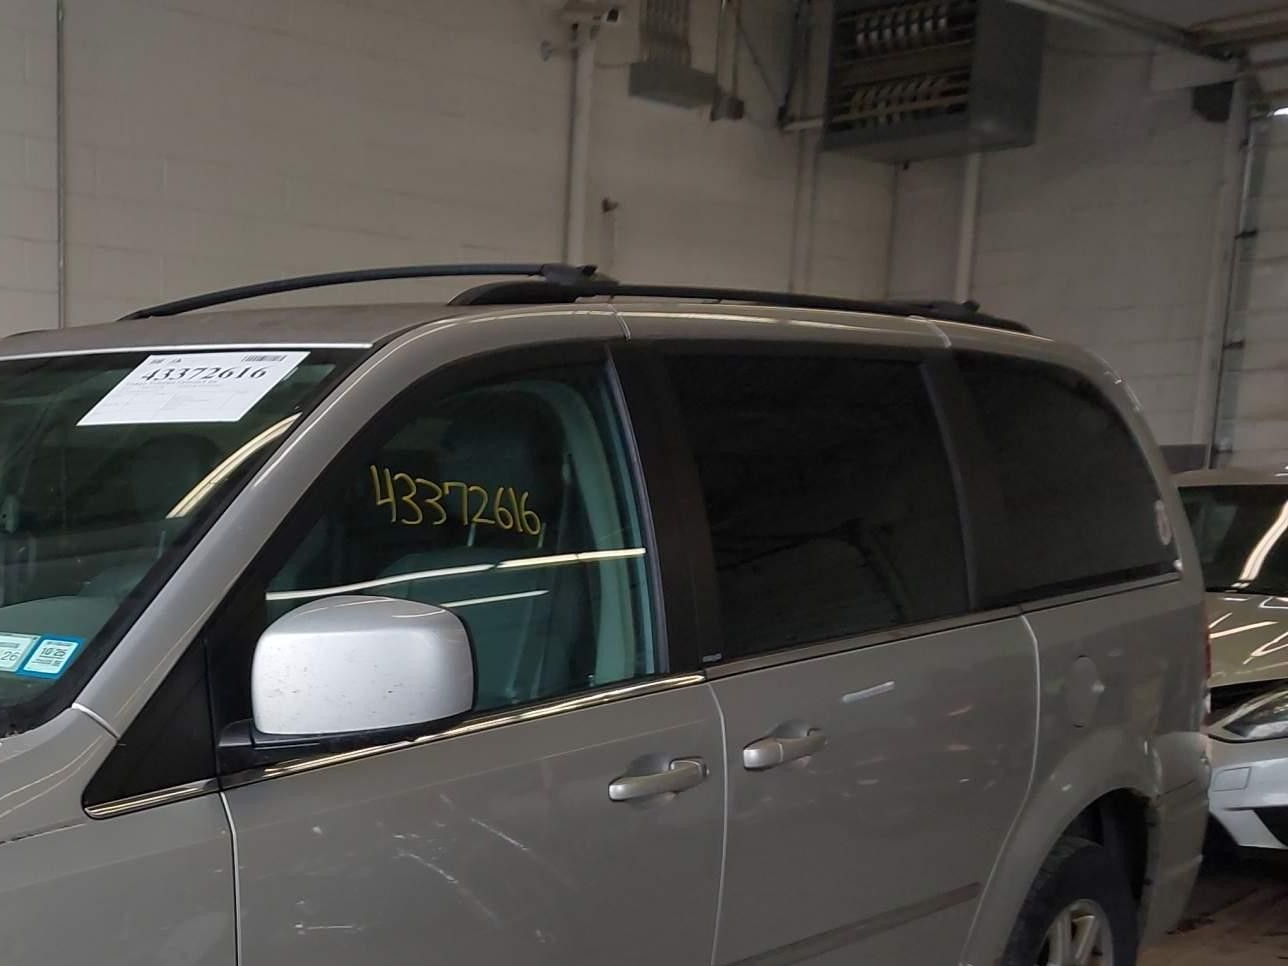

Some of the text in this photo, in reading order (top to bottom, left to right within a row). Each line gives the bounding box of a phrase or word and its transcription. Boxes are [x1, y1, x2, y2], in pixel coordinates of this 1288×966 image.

[142, 366, 268, 380] 43372616
[370, 464, 541, 535] 43372616
[1, 651, 20, 660] 26
